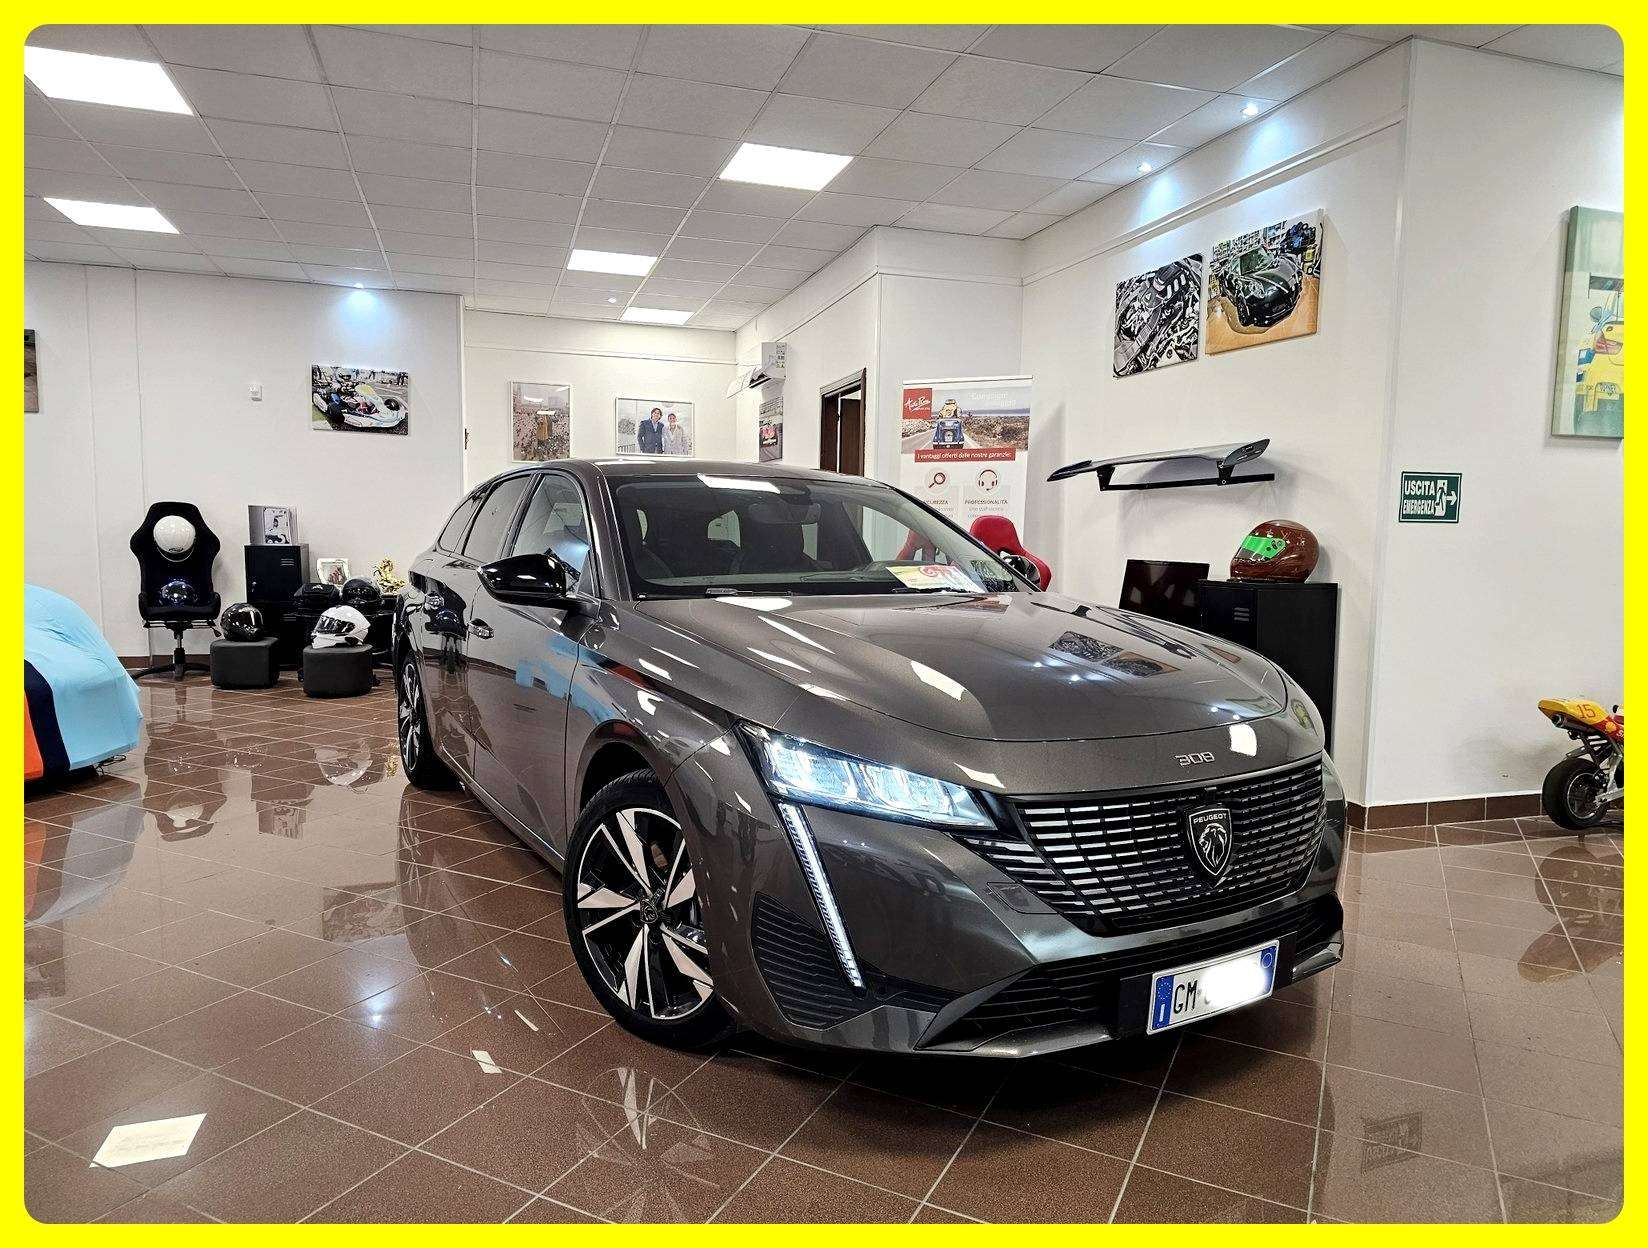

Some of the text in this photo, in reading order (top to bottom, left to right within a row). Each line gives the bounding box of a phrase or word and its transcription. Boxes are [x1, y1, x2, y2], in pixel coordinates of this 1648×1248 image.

[1404, 480, 1435, 496] USCITA
[1403, 500, 1435, 515] EMERGENZA
[1576, 704, 1596, 719] 15
[1175, 752, 1215, 766] 308
[1193, 813, 1227, 825] PEUGEOT
